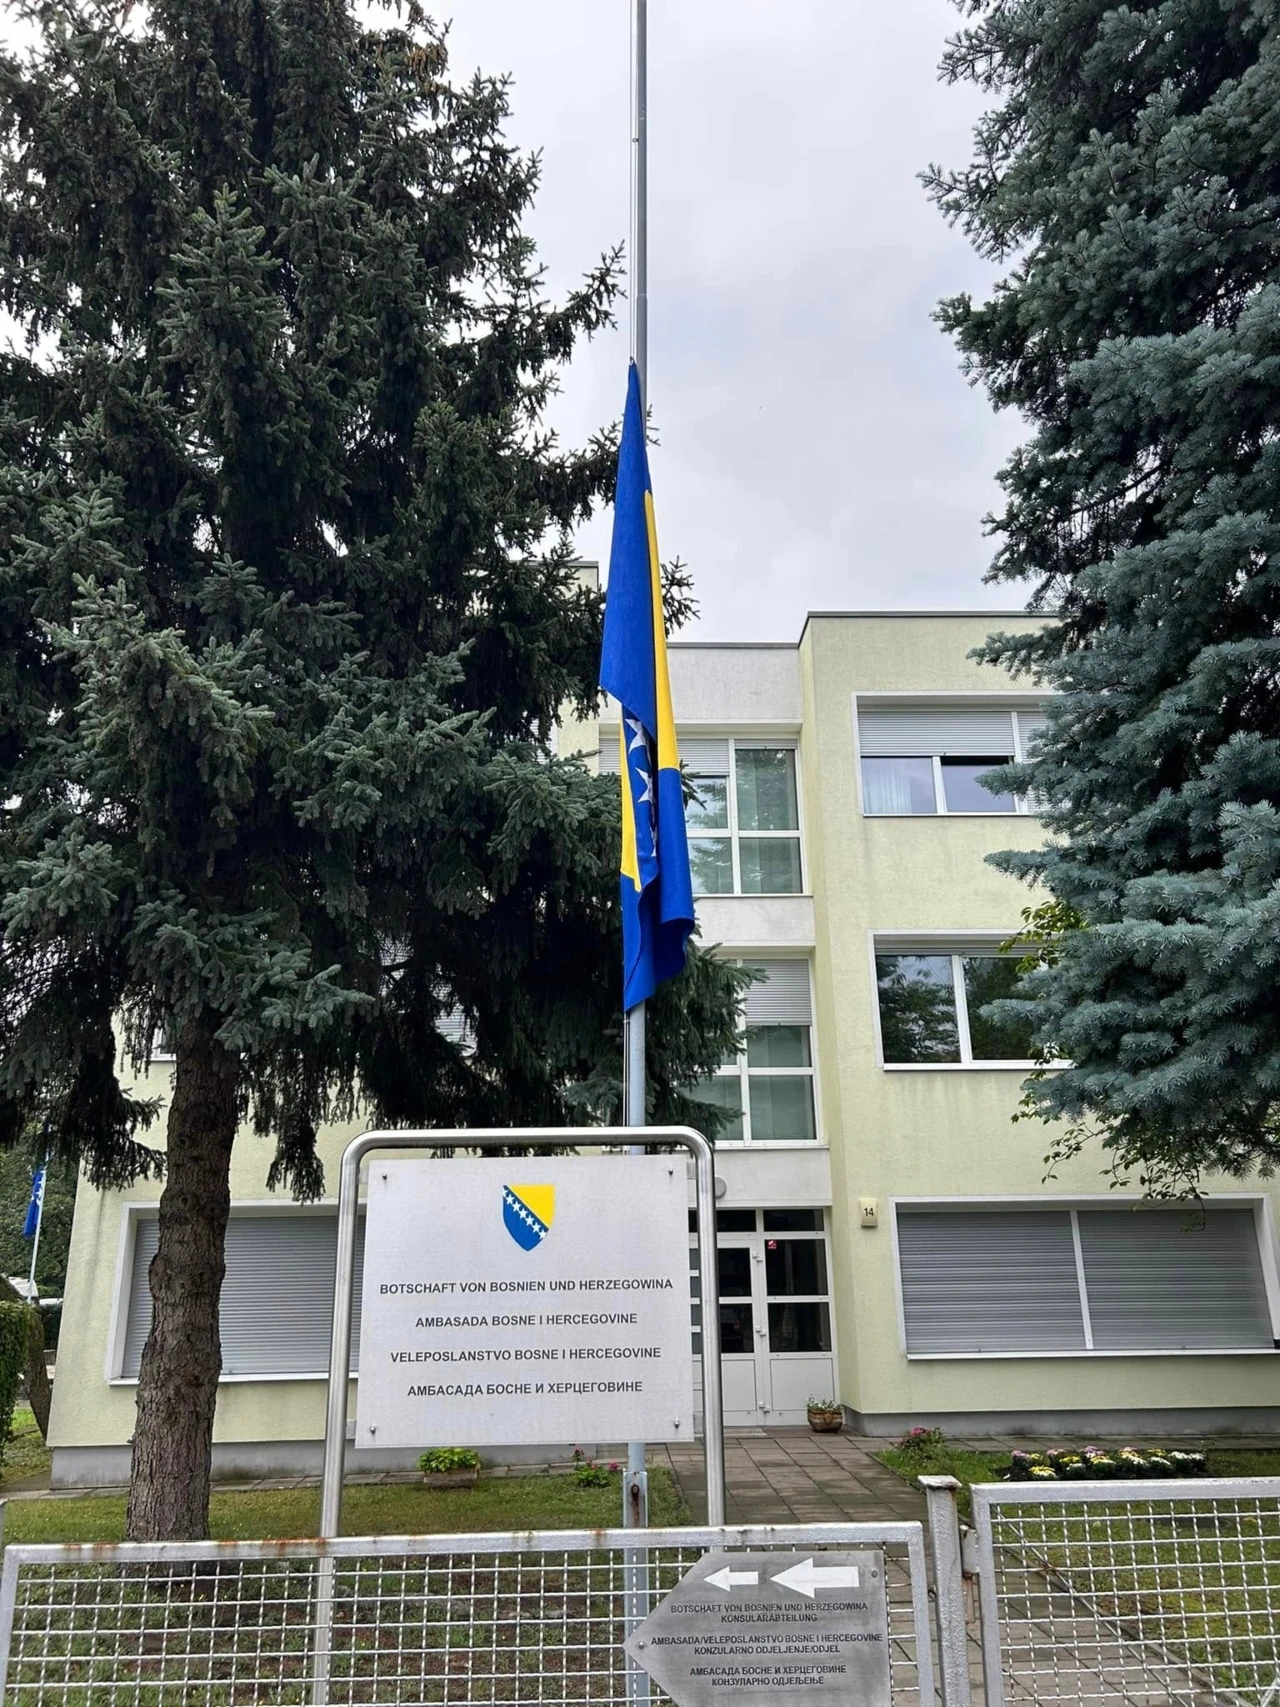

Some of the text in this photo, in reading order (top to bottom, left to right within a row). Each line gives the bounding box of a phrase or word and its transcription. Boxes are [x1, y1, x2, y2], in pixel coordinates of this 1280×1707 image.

[864, 1207, 873, 1217] 14
[380, 1279, 673, 1294] BOTSCHAFT VON BOSNIEN UND HERZEGOWINA
[415, 1313, 637, 1327] AMBASADA BOSNE I HERCEGOVINE
[390, 1347, 661, 1362] VELEPOSLANSTVO BOSNE I HERCEGOVINE
[407, 1381, 643, 1397] АМБАСАДА БОСНЕ И ХЕРЦЕГОВИНЕ
[670, 1602, 868, 1613] BOTSCHAFT VON BOSNIEN UND HERZEGOWINA
[721, 1614, 818, 1623] KONSULARABTEILUNG
[651, 1635, 783, 1645] AMBASADA/VELEPOSLANSTVO
[821, 1634, 883, 1642] HERCEGOVINE
[694, 1645, 840, 1655] KONZULARNO ODJELJENJE/ODJEL
[690, 1665, 846, 1676] АМБАСАДА БОСНЕ И ХЕРЦЕГОВИНЕ
[712, 1677, 770, 1686] КОНЗУЛАРНО
